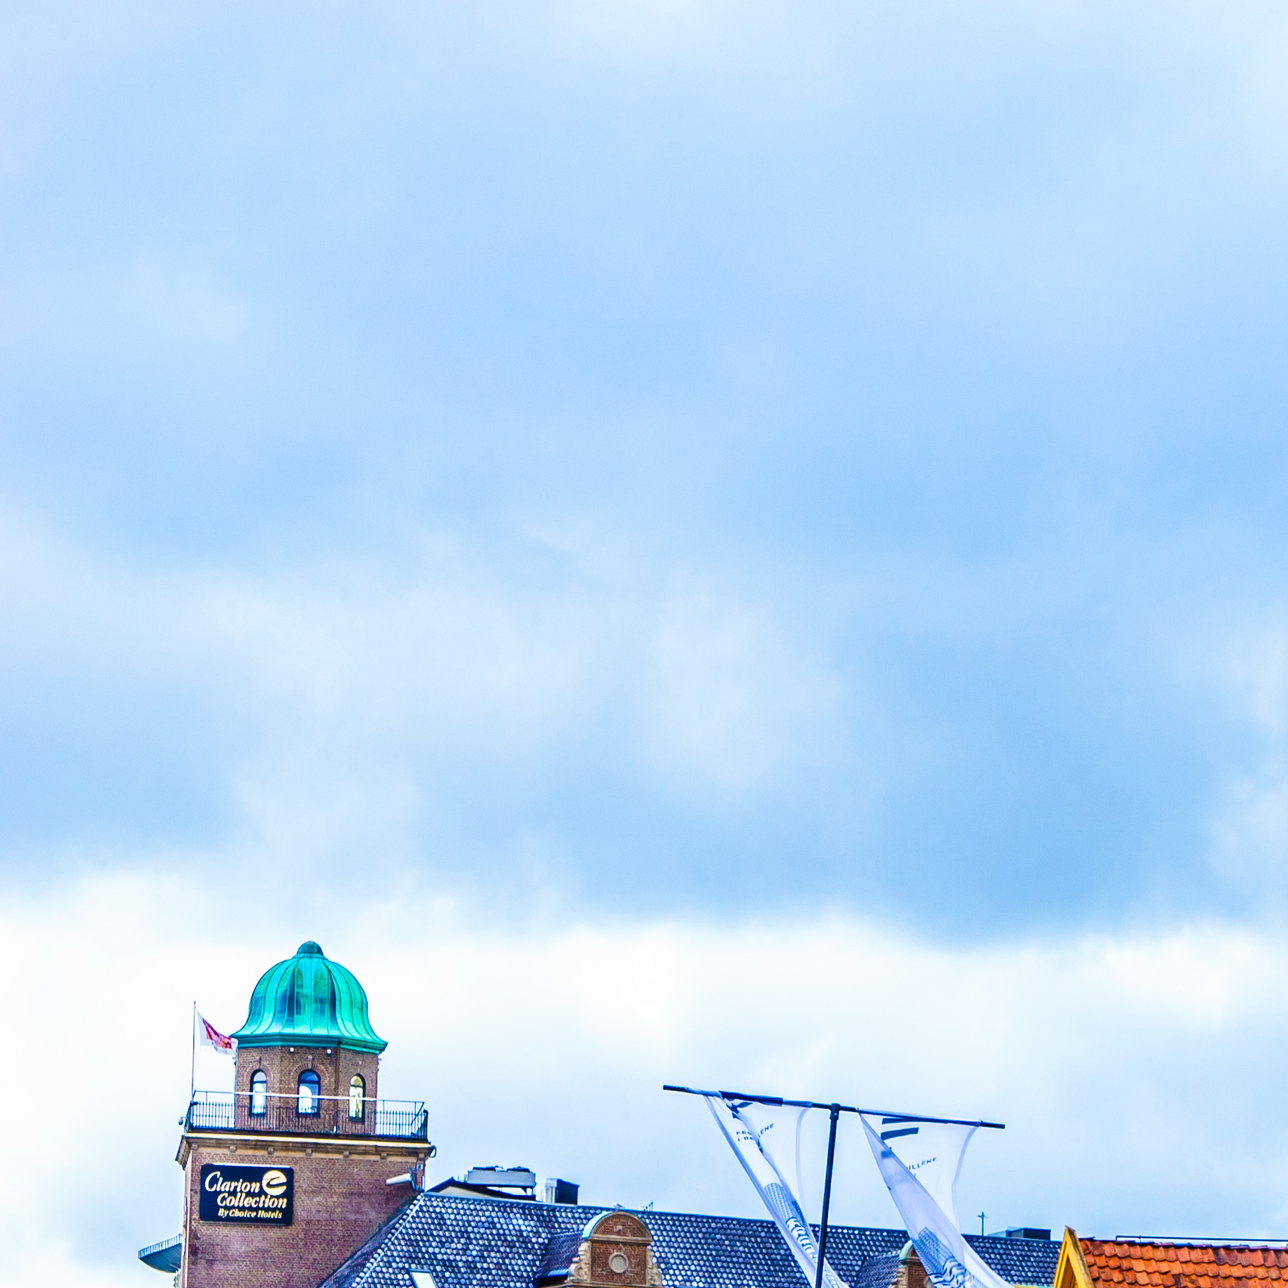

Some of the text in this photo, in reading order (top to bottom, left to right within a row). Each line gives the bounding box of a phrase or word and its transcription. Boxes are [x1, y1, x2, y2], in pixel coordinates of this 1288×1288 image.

[205, 1171, 260, 1193] Clarion
[216, 1192, 287, 1209] Collection
[218, 1208, 282, 1219] By Choice Hotels
